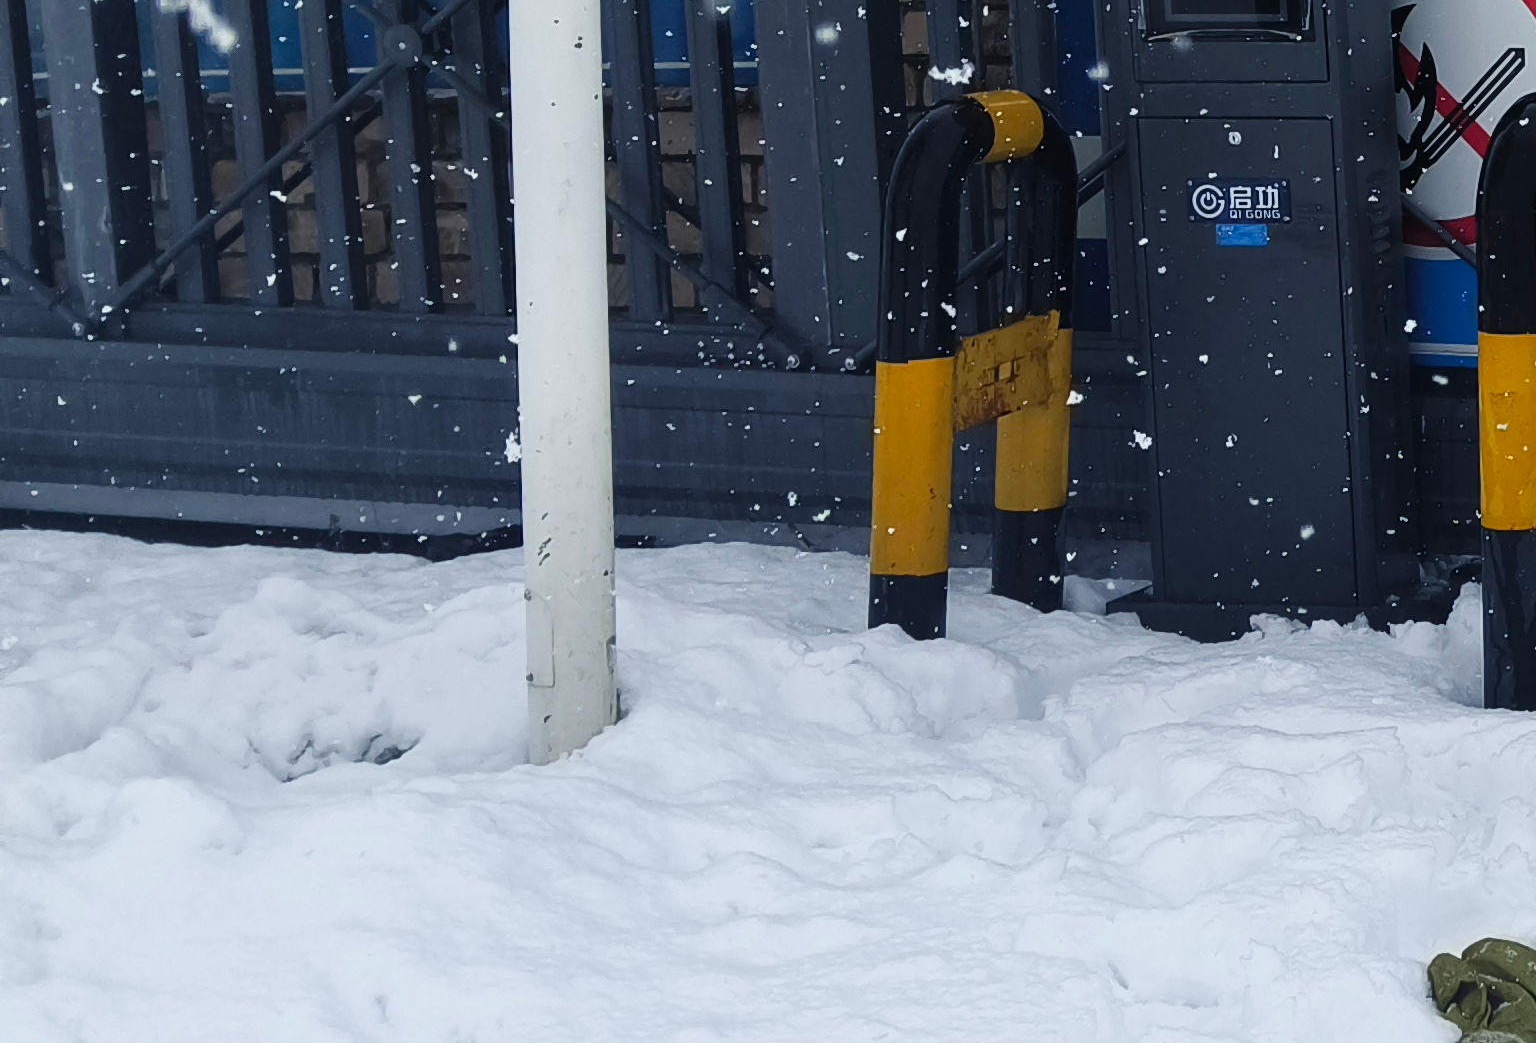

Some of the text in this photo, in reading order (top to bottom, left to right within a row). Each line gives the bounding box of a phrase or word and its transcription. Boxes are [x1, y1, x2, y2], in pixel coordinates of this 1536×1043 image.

[1229, 185, 1279, 209] 启功
[1229, 209, 1281, 219] QI GONG
